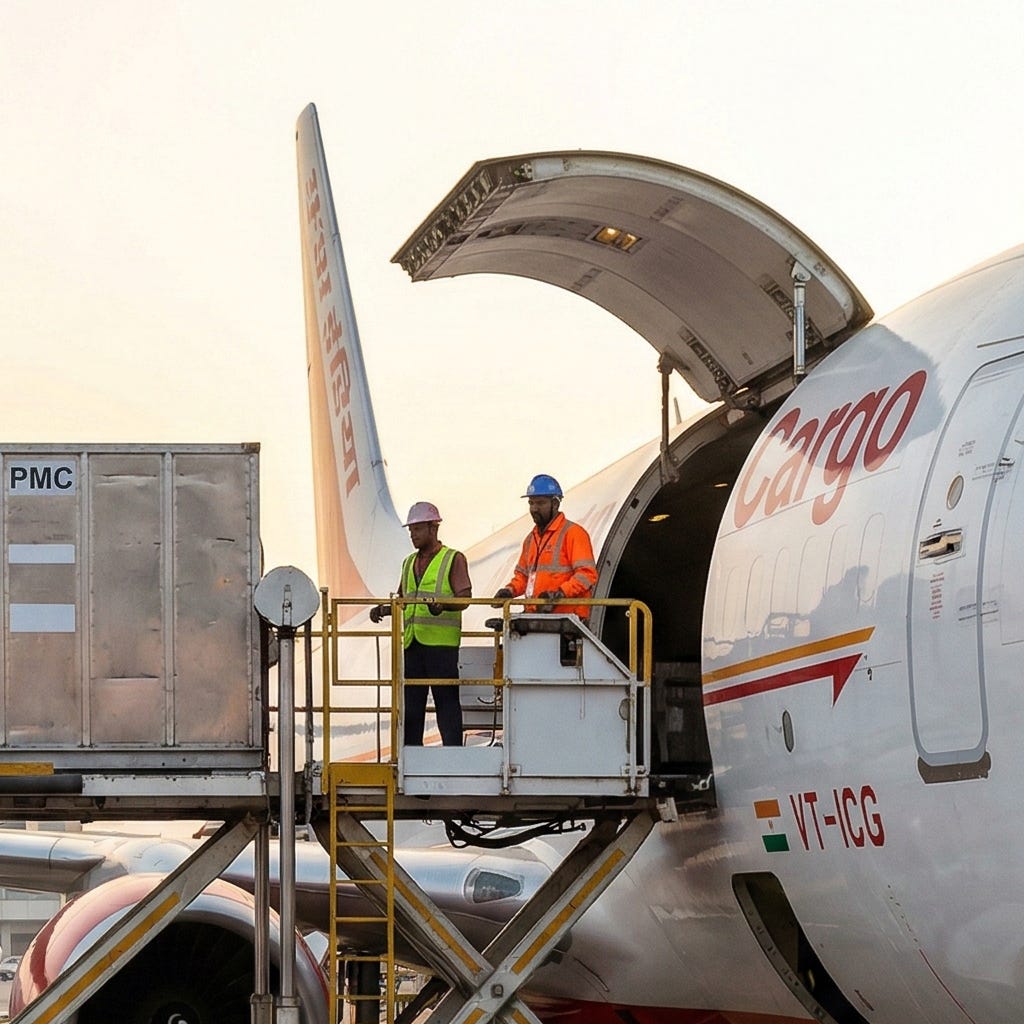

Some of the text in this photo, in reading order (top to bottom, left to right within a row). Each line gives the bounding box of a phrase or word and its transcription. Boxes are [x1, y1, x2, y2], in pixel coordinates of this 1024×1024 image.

[10, 466, 73, 490] PMC
[734, 370, 927, 528] Cargo
[789, 785, 885, 850] VT-ICG
